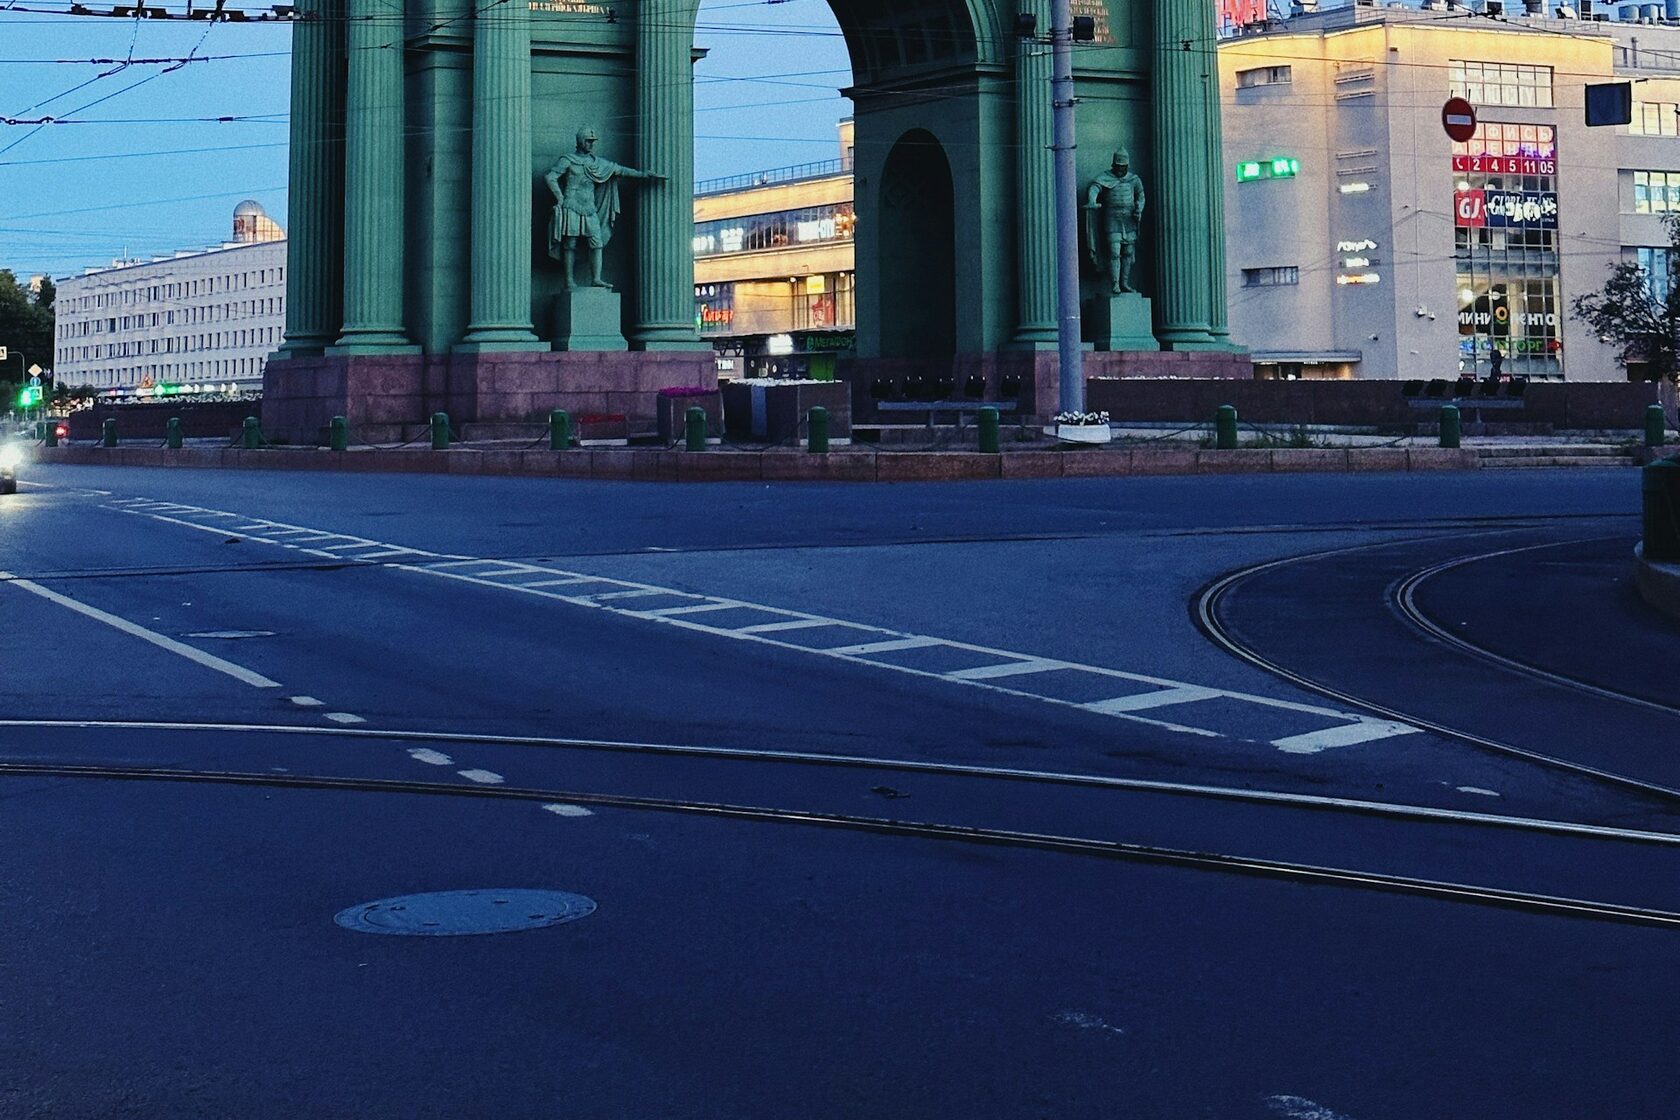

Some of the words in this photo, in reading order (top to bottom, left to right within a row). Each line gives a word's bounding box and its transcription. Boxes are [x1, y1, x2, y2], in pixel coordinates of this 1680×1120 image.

[1473, 158, 1480, 171] 2
[1491, 159, 1498, 172] 4
[1509, 160, 1516, 172] 5
[1524, 161, 1536, 173] 11
[1540, 162, 1554, 174] 05
[1459, 197, 1481, 219] GJ
